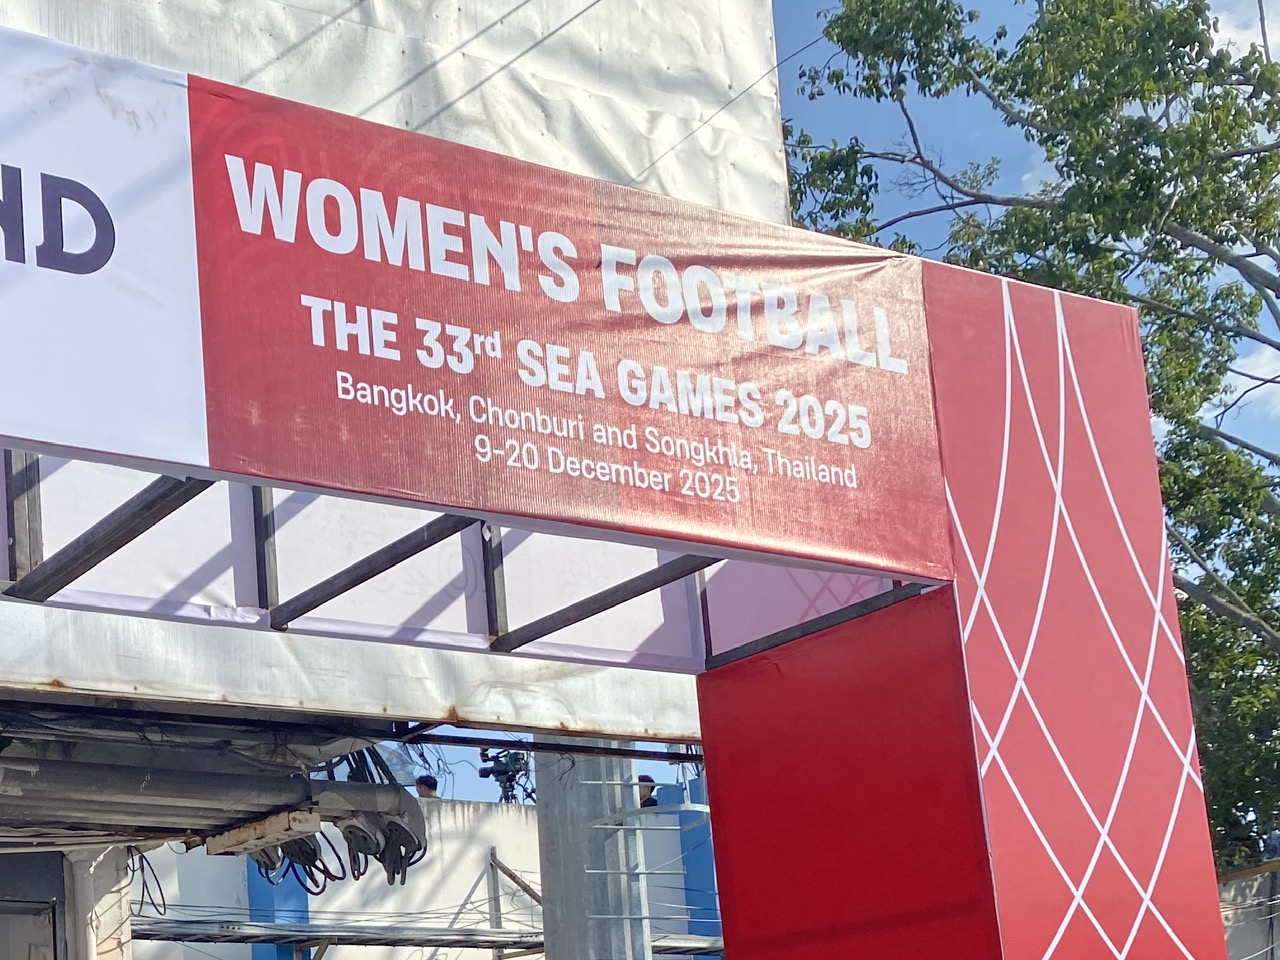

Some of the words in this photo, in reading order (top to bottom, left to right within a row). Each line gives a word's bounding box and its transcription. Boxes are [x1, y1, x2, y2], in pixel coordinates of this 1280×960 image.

[225, 153, 579, 303] WOMEN'S
[600, 243, 908, 374] FOOTBALL
[300, 294, 401, 360] THE
[415, 317, 501, 374] 33rd
[517, 339, 605, 399] SEA
[618, 359, 764, 428] GAMES
[775, 391, 871, 449] 2025
[336, 371, 461, 423] Bangkok,
[468, 395, 584, 441] Chonburi
[593, 420, 637, 449] and
[645, 427, 758, 474] Songkhla,
[762, 448, 857, 489] Thailand
[548, 447, 671, 493] December
[680, 471, 740, 502] 2025
